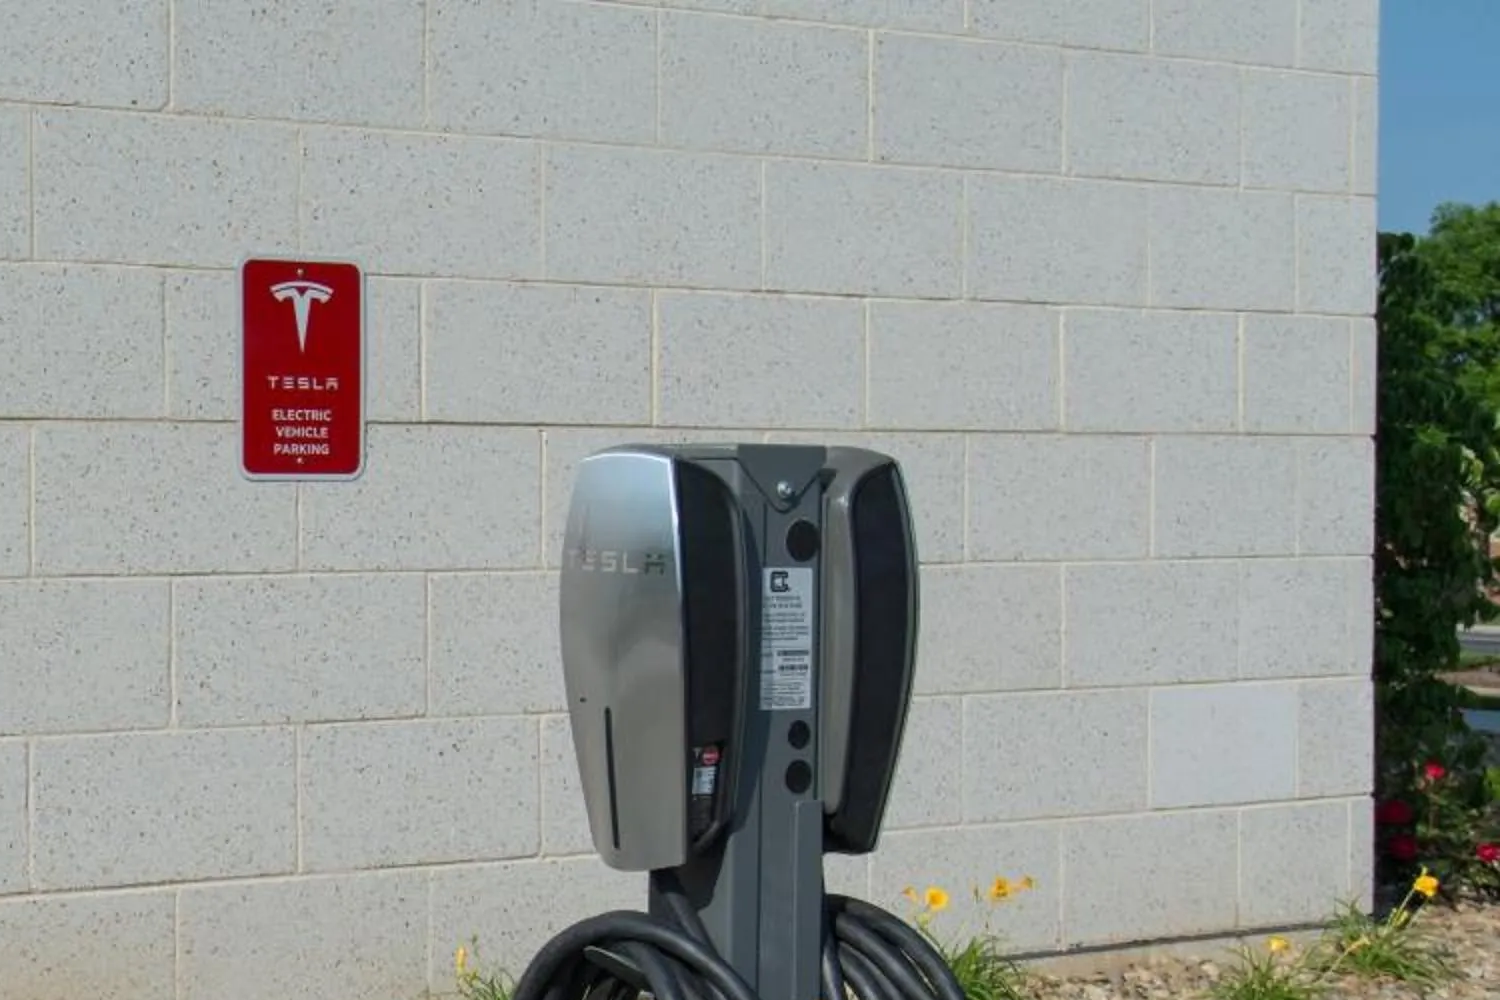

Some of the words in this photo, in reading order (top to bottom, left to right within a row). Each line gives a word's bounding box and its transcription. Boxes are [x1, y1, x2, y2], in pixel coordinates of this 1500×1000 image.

[266, 375, 338, 390] TESLA
[272, 409, 332, 421] ELECTRIC
[276, 426, 329, 438] VEHICLE
[273, 443, 330, 455] PARKING
